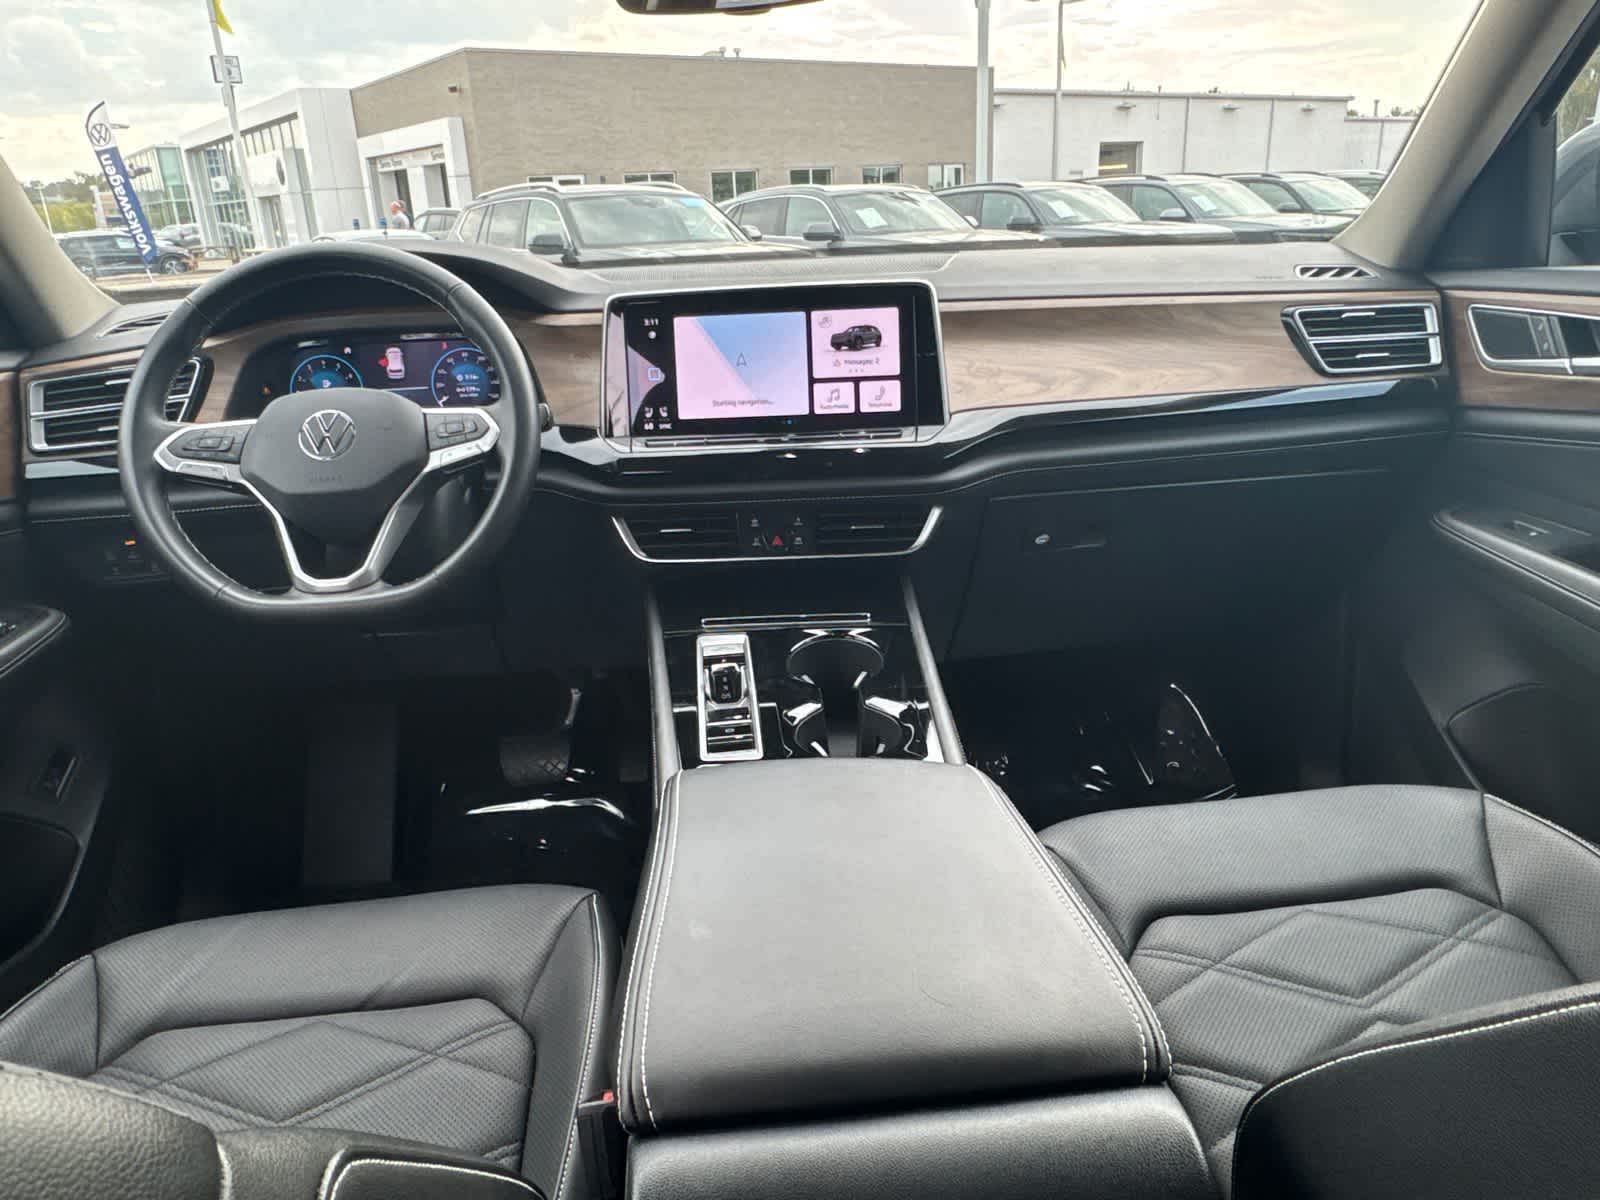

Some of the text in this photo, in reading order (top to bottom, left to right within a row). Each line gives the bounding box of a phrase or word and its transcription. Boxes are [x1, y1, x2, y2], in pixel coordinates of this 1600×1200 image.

[90, 123, 111, 147] VW
[101, 154, 152, 255] Volkswagen
[298, 409, 356, 461] VW
